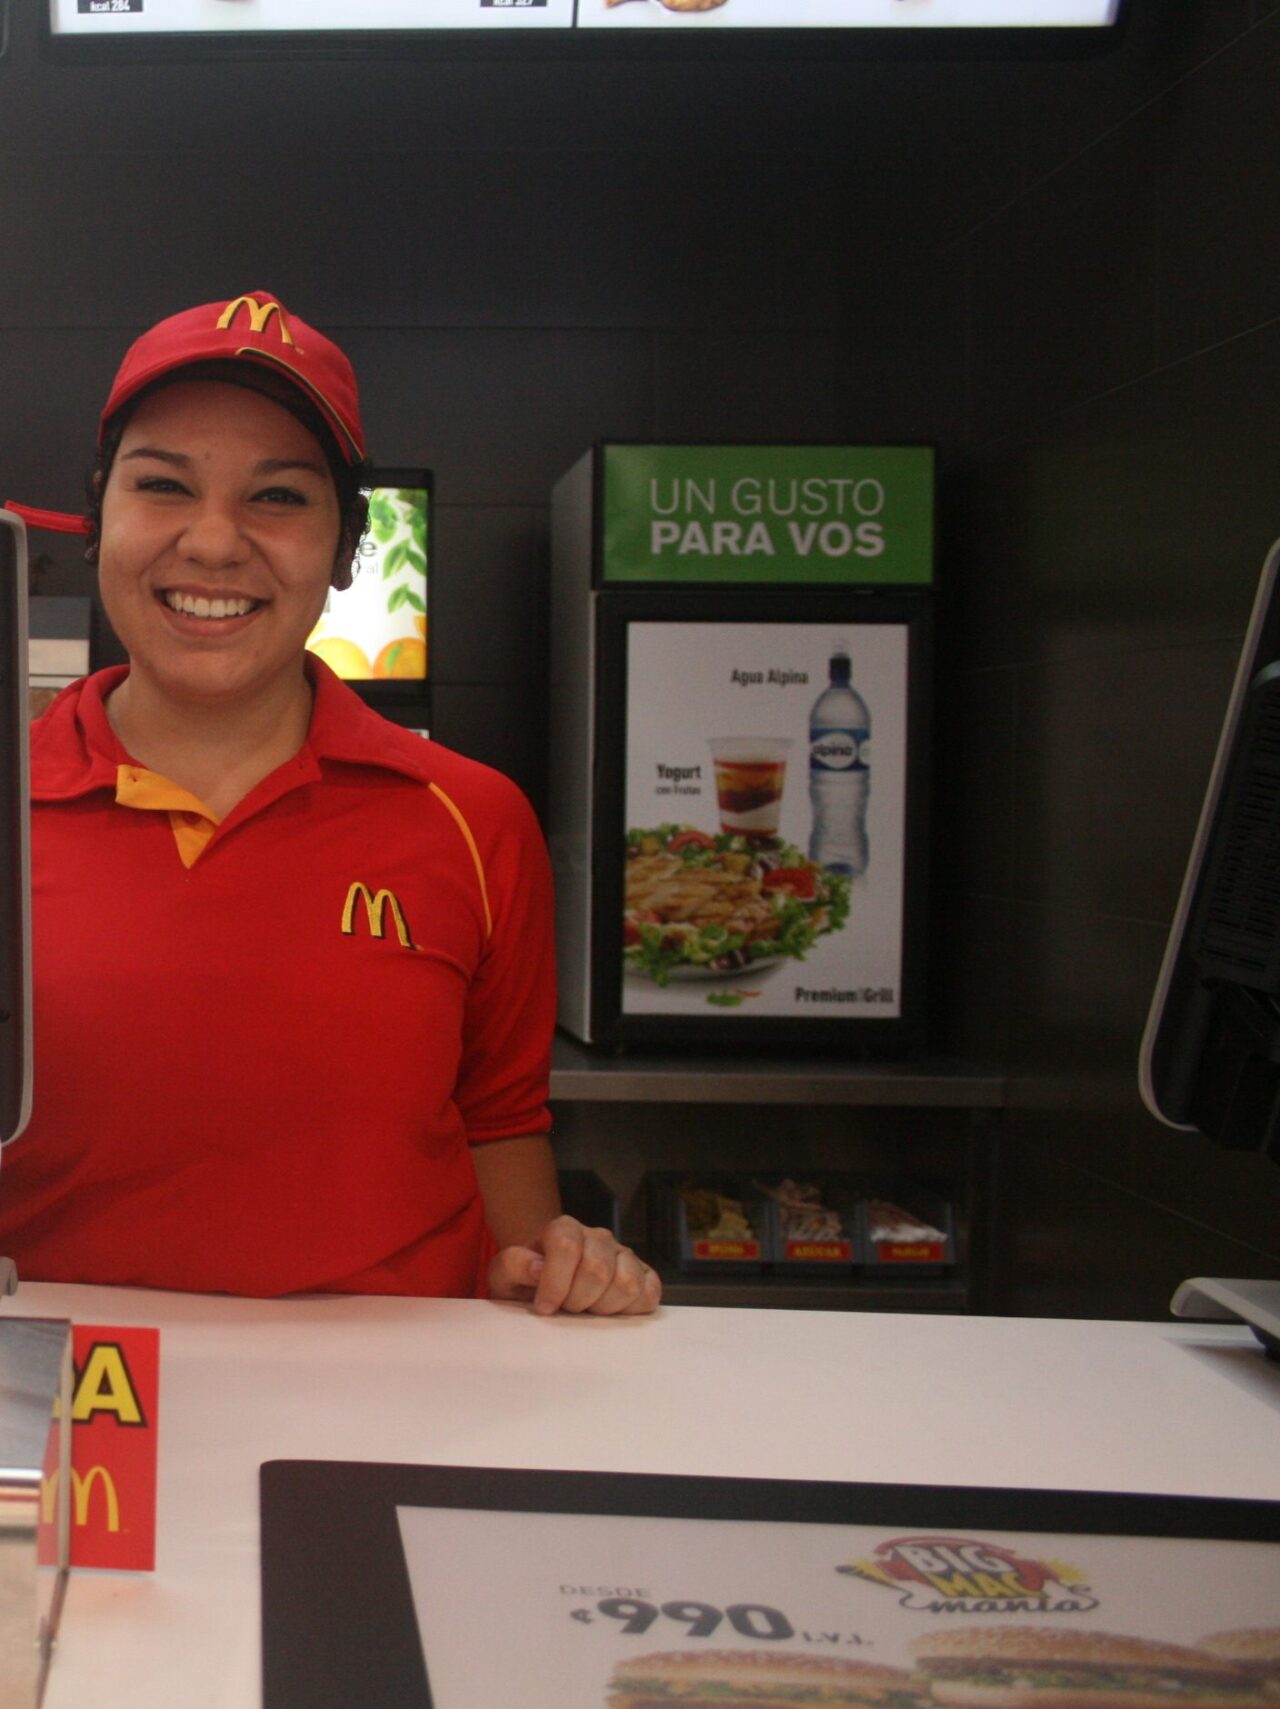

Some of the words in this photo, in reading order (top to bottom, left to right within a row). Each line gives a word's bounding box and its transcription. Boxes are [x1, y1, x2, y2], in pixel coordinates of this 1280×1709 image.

[650, 478, 716, 515] UN
[731, 477, 885, 516] GUSTO
[651, 521, 775, 555] PARA
[787, 521, 885, 557] VOS
[731, 668, 763, 687] Agua
[767, 668, 809, 686] Alpina
[656, 764, 701, 782] Yogurt
[795, 986, 858, 1003] Premium
[863, 987, 894, 1004] Grill
[894, 1544, 1016, 1573] BIG
[558, 1584, 652, 1598] DESDE
[928, 1571, 1044, 1599] MAC
